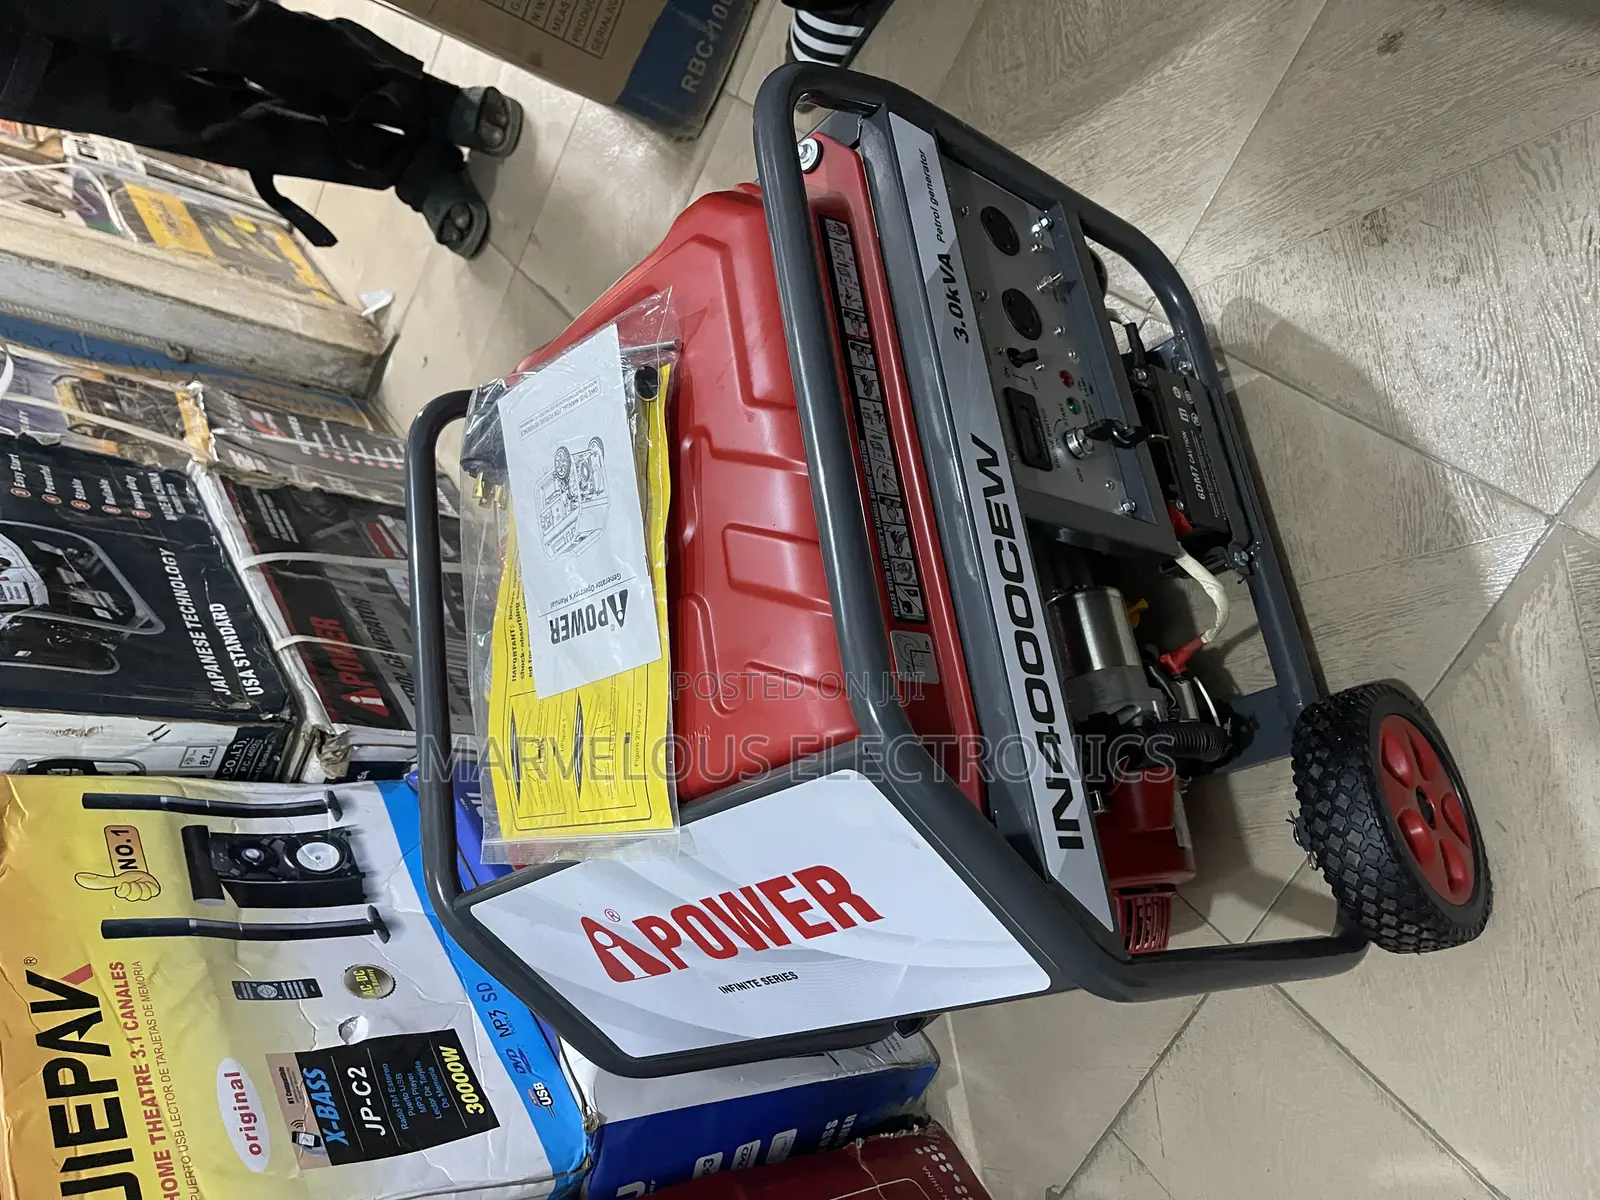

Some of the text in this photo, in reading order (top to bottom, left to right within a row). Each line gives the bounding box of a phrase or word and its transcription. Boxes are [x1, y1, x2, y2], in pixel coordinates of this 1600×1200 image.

[918, 148, 970, 344] 3.0kVA Petrol generator
[860, 440, 871, 474] OPERATION
[1181, 430, 1206, 501] 6DM7 CAUTION
[158, 547, 203, 630] TECHNOLOGY
[889, 592, 899, 617] PLEASE
[208, 602, 254, 668] STANDARD
[508, 625, 519, 682] IMPORTANT:
[515, 601, 527, 681] shock-absorbing
[970, 433, 1084, 850] IN4000CEW
[188, 630, 233, 696] JAPANESE
[240, 668, 266, 697] USA
[111, 827, 138, 871] NO.1
[108, 961, 139, 1032] CANALES
[131, 960, 153, 1002] MEMORIA
[476, 980, 499, 1004] SD
[718, 970, 799, 995] INFINITE SERIES
[142, 1004, 155, 1018] DE
[488, 1008, 514, 1038] MP3
[125, 1034, 146, 1059] 3.1
[146, 1019, 168, 1067] TARJETAS
[159, 1068, 171, 1083] DE
[381, 1063, 411, 1130] Radio FM Estereo
[395, 1072, 417, 1117] Puerto USB
[412, 1060, 443, 1119] Lector De Tarjeta
[426, 1066, 445, 1097] Memoria
[439, 1045, 486, 1115] 30000W
[533, 1082, 551, 1106] USB
[132, 1063, 167, 1145] THEATRE
[161, 1084, 183, 1128] LECTOR
[224, 1070, 264, 1156] original
[302, 1067, 349, 1146] X-BASS
[346, 1066, 388, 1137] JP-C2
[415, 1096, 429, 1114] MP3
[174, 1129, 189, 1154] USB
[920, 1165, 943, 1192] CHINA
